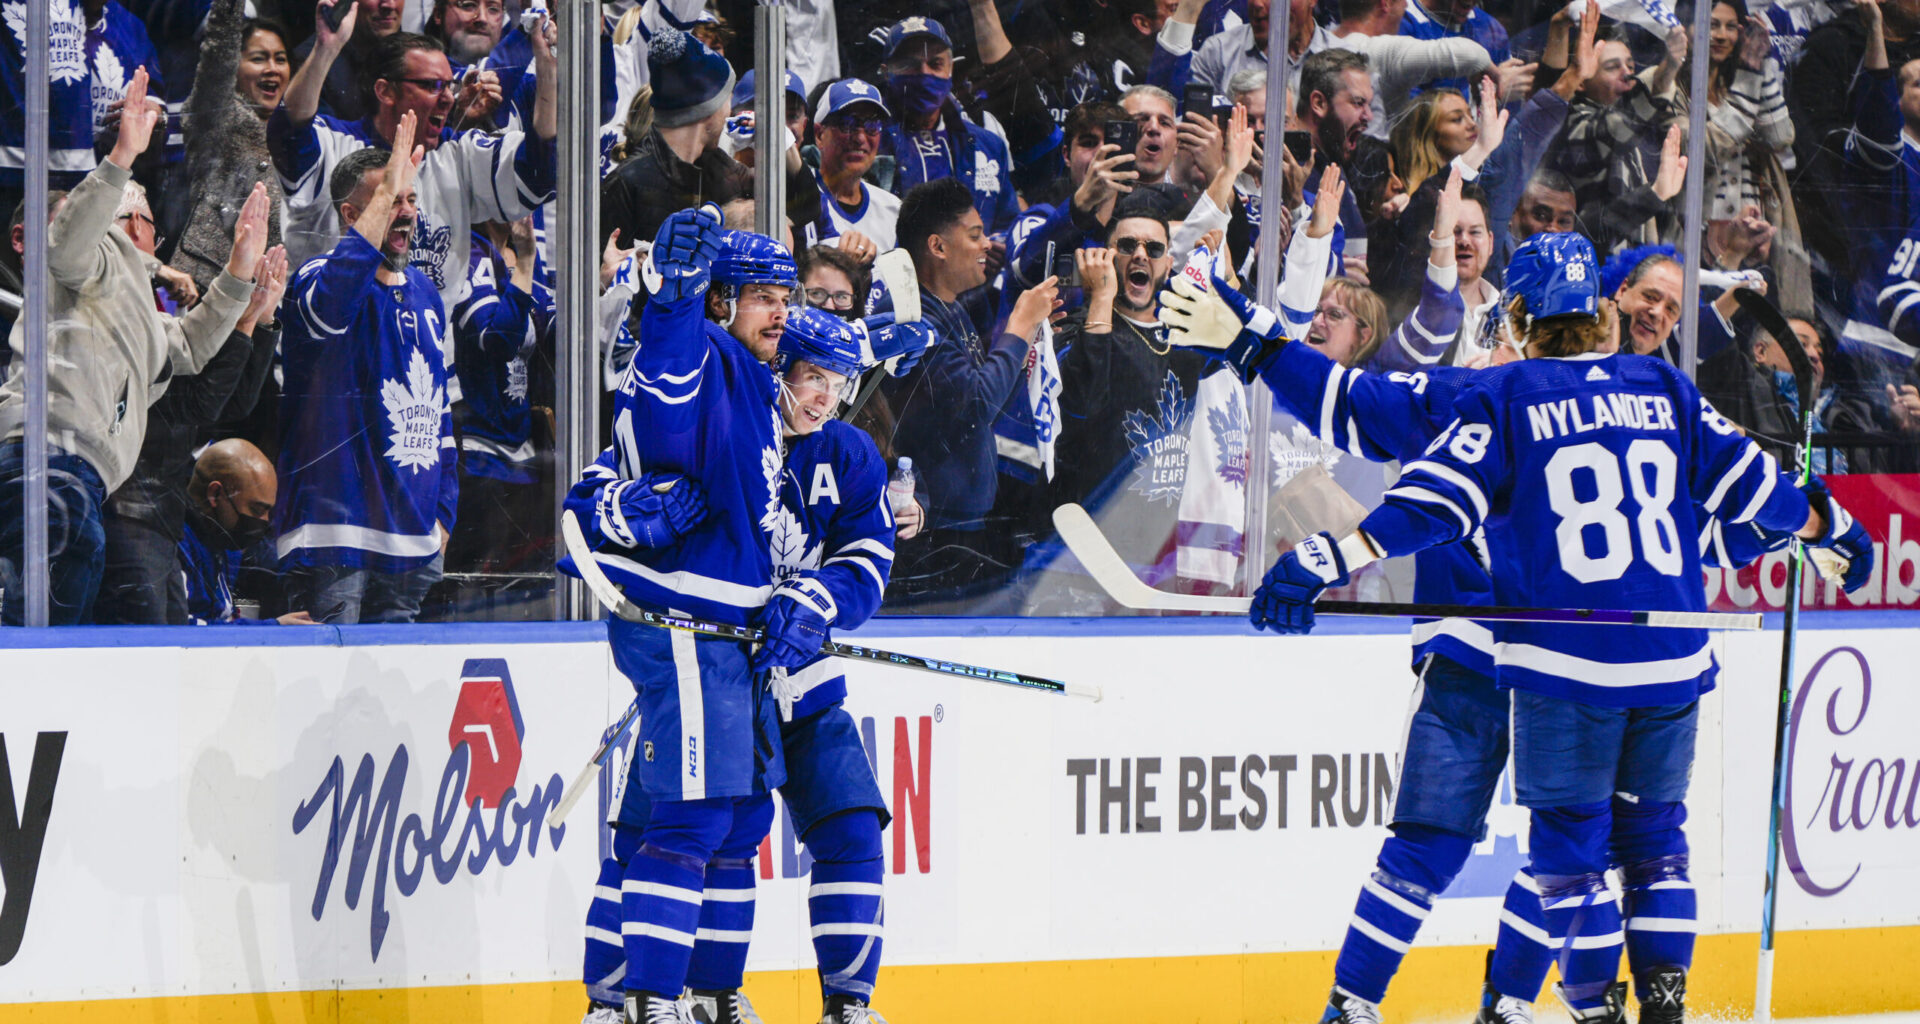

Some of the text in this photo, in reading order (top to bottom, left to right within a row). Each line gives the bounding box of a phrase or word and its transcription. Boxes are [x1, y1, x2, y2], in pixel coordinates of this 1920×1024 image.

[49, 51, 79, 63] LEAFS
[773, 264, 795, 273] CCM
[1566, 263, 1585, 282] 88
[424, 309, 446, 352] C
[398, 404, 439, 426] TORONTO
[405, 419, 434, 436] MAPLE
[1526, 392, 1676, 442] NYLANDER
[403, 436, 433, 449] LEAFS
[1152, 468, 1184, 483] LEAFS
[1154, 453, 1185, 469] MAPLE
[808, 463, 841, 506] A
[1544, 439, 1683, 584] 88
[660, 616, 718, 632] TRUE
[934, 660, 1018, 682] TRUE
[688, 735, 697, 778] CCM
[1066, 756, 1162, 835] THE
[1178, 753, 1298, 833] BEST
[292, 742, 566, 963] Molson
